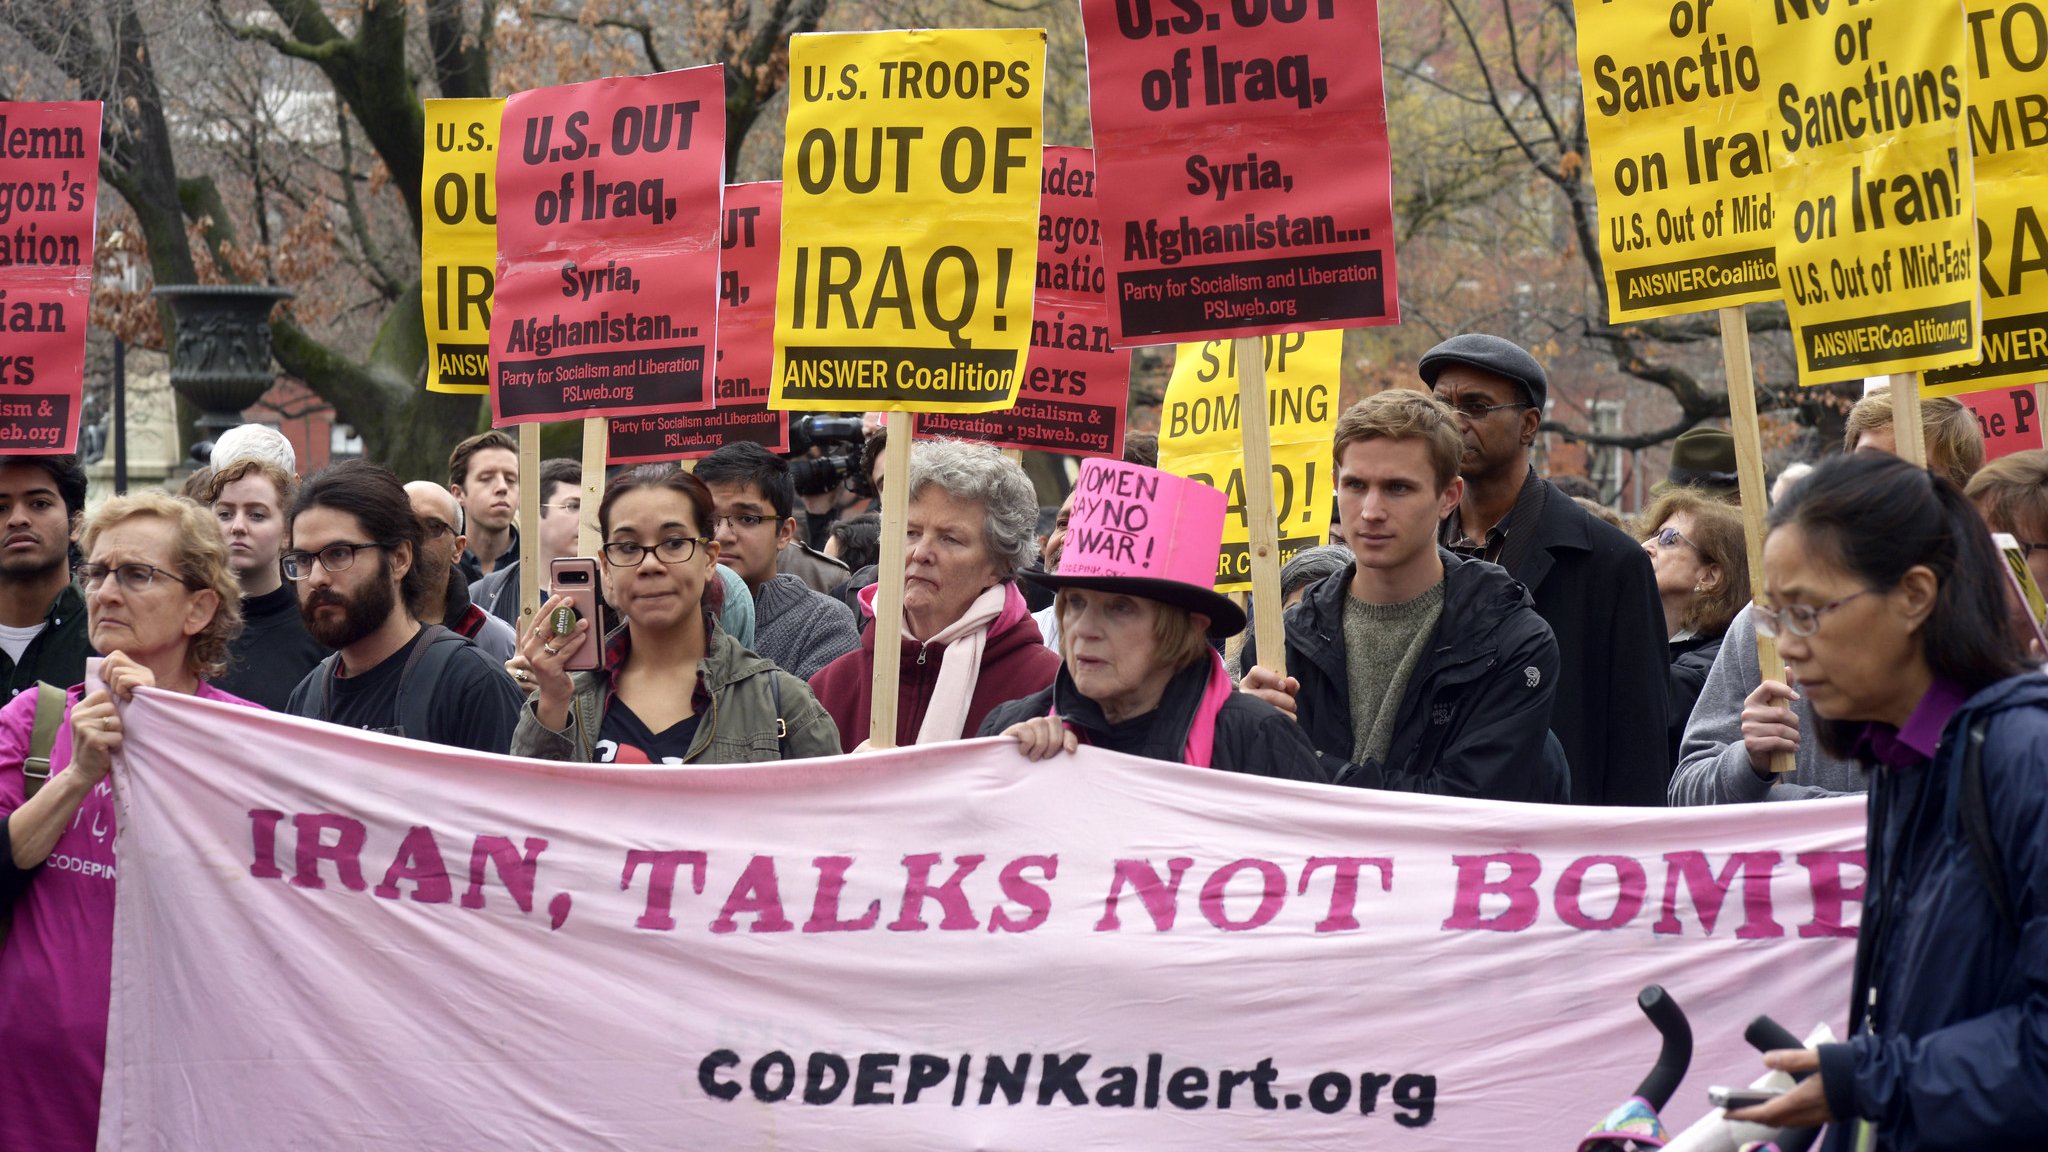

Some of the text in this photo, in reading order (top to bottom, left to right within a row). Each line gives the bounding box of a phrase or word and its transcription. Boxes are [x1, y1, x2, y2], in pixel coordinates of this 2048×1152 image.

[1669, 0, 1715, 38] or
[1835, 17, 1873, 66] or
[1967, 2, 2048, 80] TO
[803, 60, 1030, 102] U.S. TROOPS
[1141, 45, 1328, 112] of Iraq,
[1594, 33, 1761, 117] Sanctio
[1778, 61, 1961, 152] Sanctions
[436, 122, 493, 152] U.S.
[523, 100, 700, 165] U.S. OUT
[797, 126, 1032, 194] OUT OF
[1185, 153, 1293, 201] Syria,
[1614, 126, 1772, 197] on Ira
[535, 170, 677, 226] of Iraq,
[1794, 147, 1962, 243] on Iran!
[1123, 213, 1371, 265] Afghanistan...
[1611, 212, 1652, 253] U.S.
[1656, 205, 1695, 246] Out
[1702, 199, 1724, 239] of
[561, 260, 641, 301] Syria,
[1124, 264, 1377, 301] Party for Socialism and Liberation
[1788, 238, 1971, 306] U.S. Out of Mid-East
[792, 245, 1013, 349] IRAQ!
[1203, 299, 1297, 320] PSLweb.org
[505, 310, 698, 356] Afghanistan...
[1197, 332, 1305, 382] SP
[1814, 318, 1967, 359] ANSWERCoalition.org
[502, 357, 699, 388] Party for Socialism and Liberation
[563, 383, 634, 403] PSLweb.org
[783, 360, 1013, 391] ANSWER Coalition
[1020, 366, 1087, 396] ers
[37, 400, 53, 417] &
[612, 410, 776, 434] Party for Socialism and Liberation
[923, 413, 1109, 448] Liberation pslweb.org
[1087, 409, 1101, 425] &
[1169, 384, 1328, 438] BOMING
[2009, 389, 2035, 433] P
[664, 433, 722, 447] PSLweb.org
[1101, 499, 1148, 532] NO
[1187, 462, 1316, 538] AQ!
[249, 809, 571, 931] IRAN,
[620, 849, 1058, 933] TALKS
[1093, 856, 1393, 934] NOT
[698, 1048, 1437, 1128] CODEPINKalert.org
